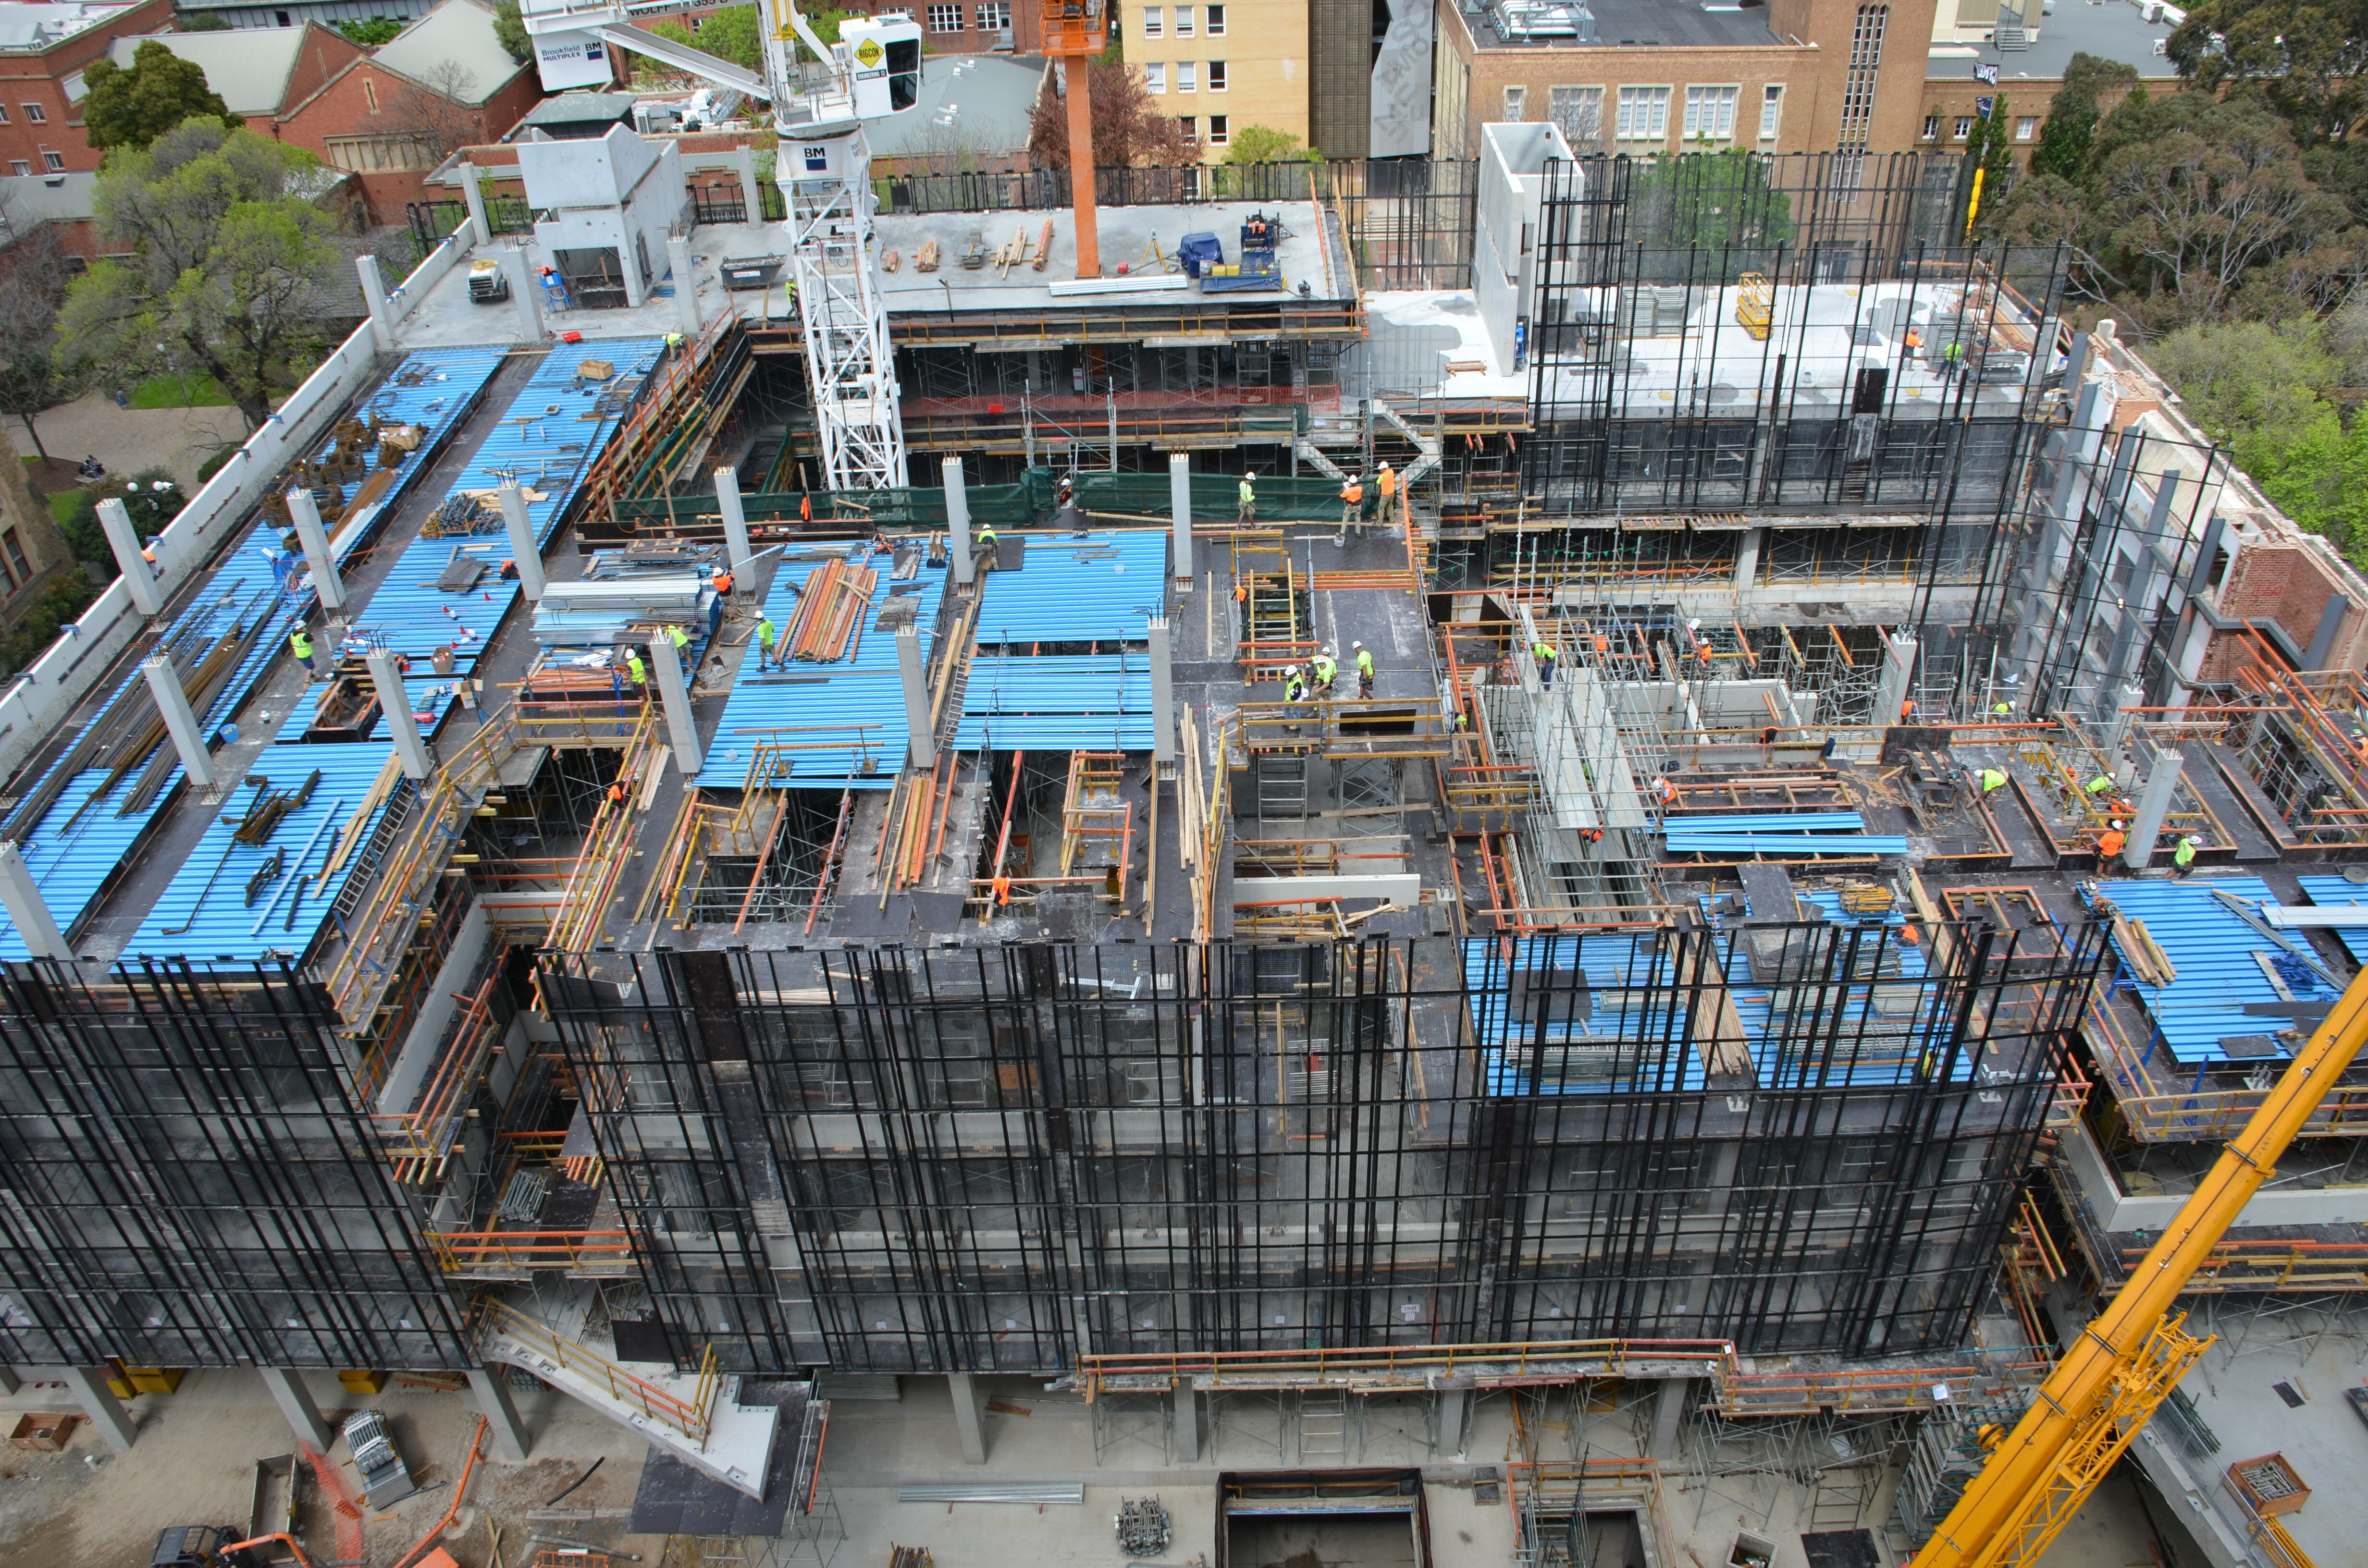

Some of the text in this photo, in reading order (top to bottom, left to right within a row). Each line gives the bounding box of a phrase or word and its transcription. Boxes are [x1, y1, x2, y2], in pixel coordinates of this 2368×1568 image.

[542, 45, 580, 57] Brookfield
[585, 42, 602, 51] BM
[543, 52, 581, 62] MULTIPLEX
[859, 47, 879, 59] RIGCON
[804, 147, 826, 158] BM
